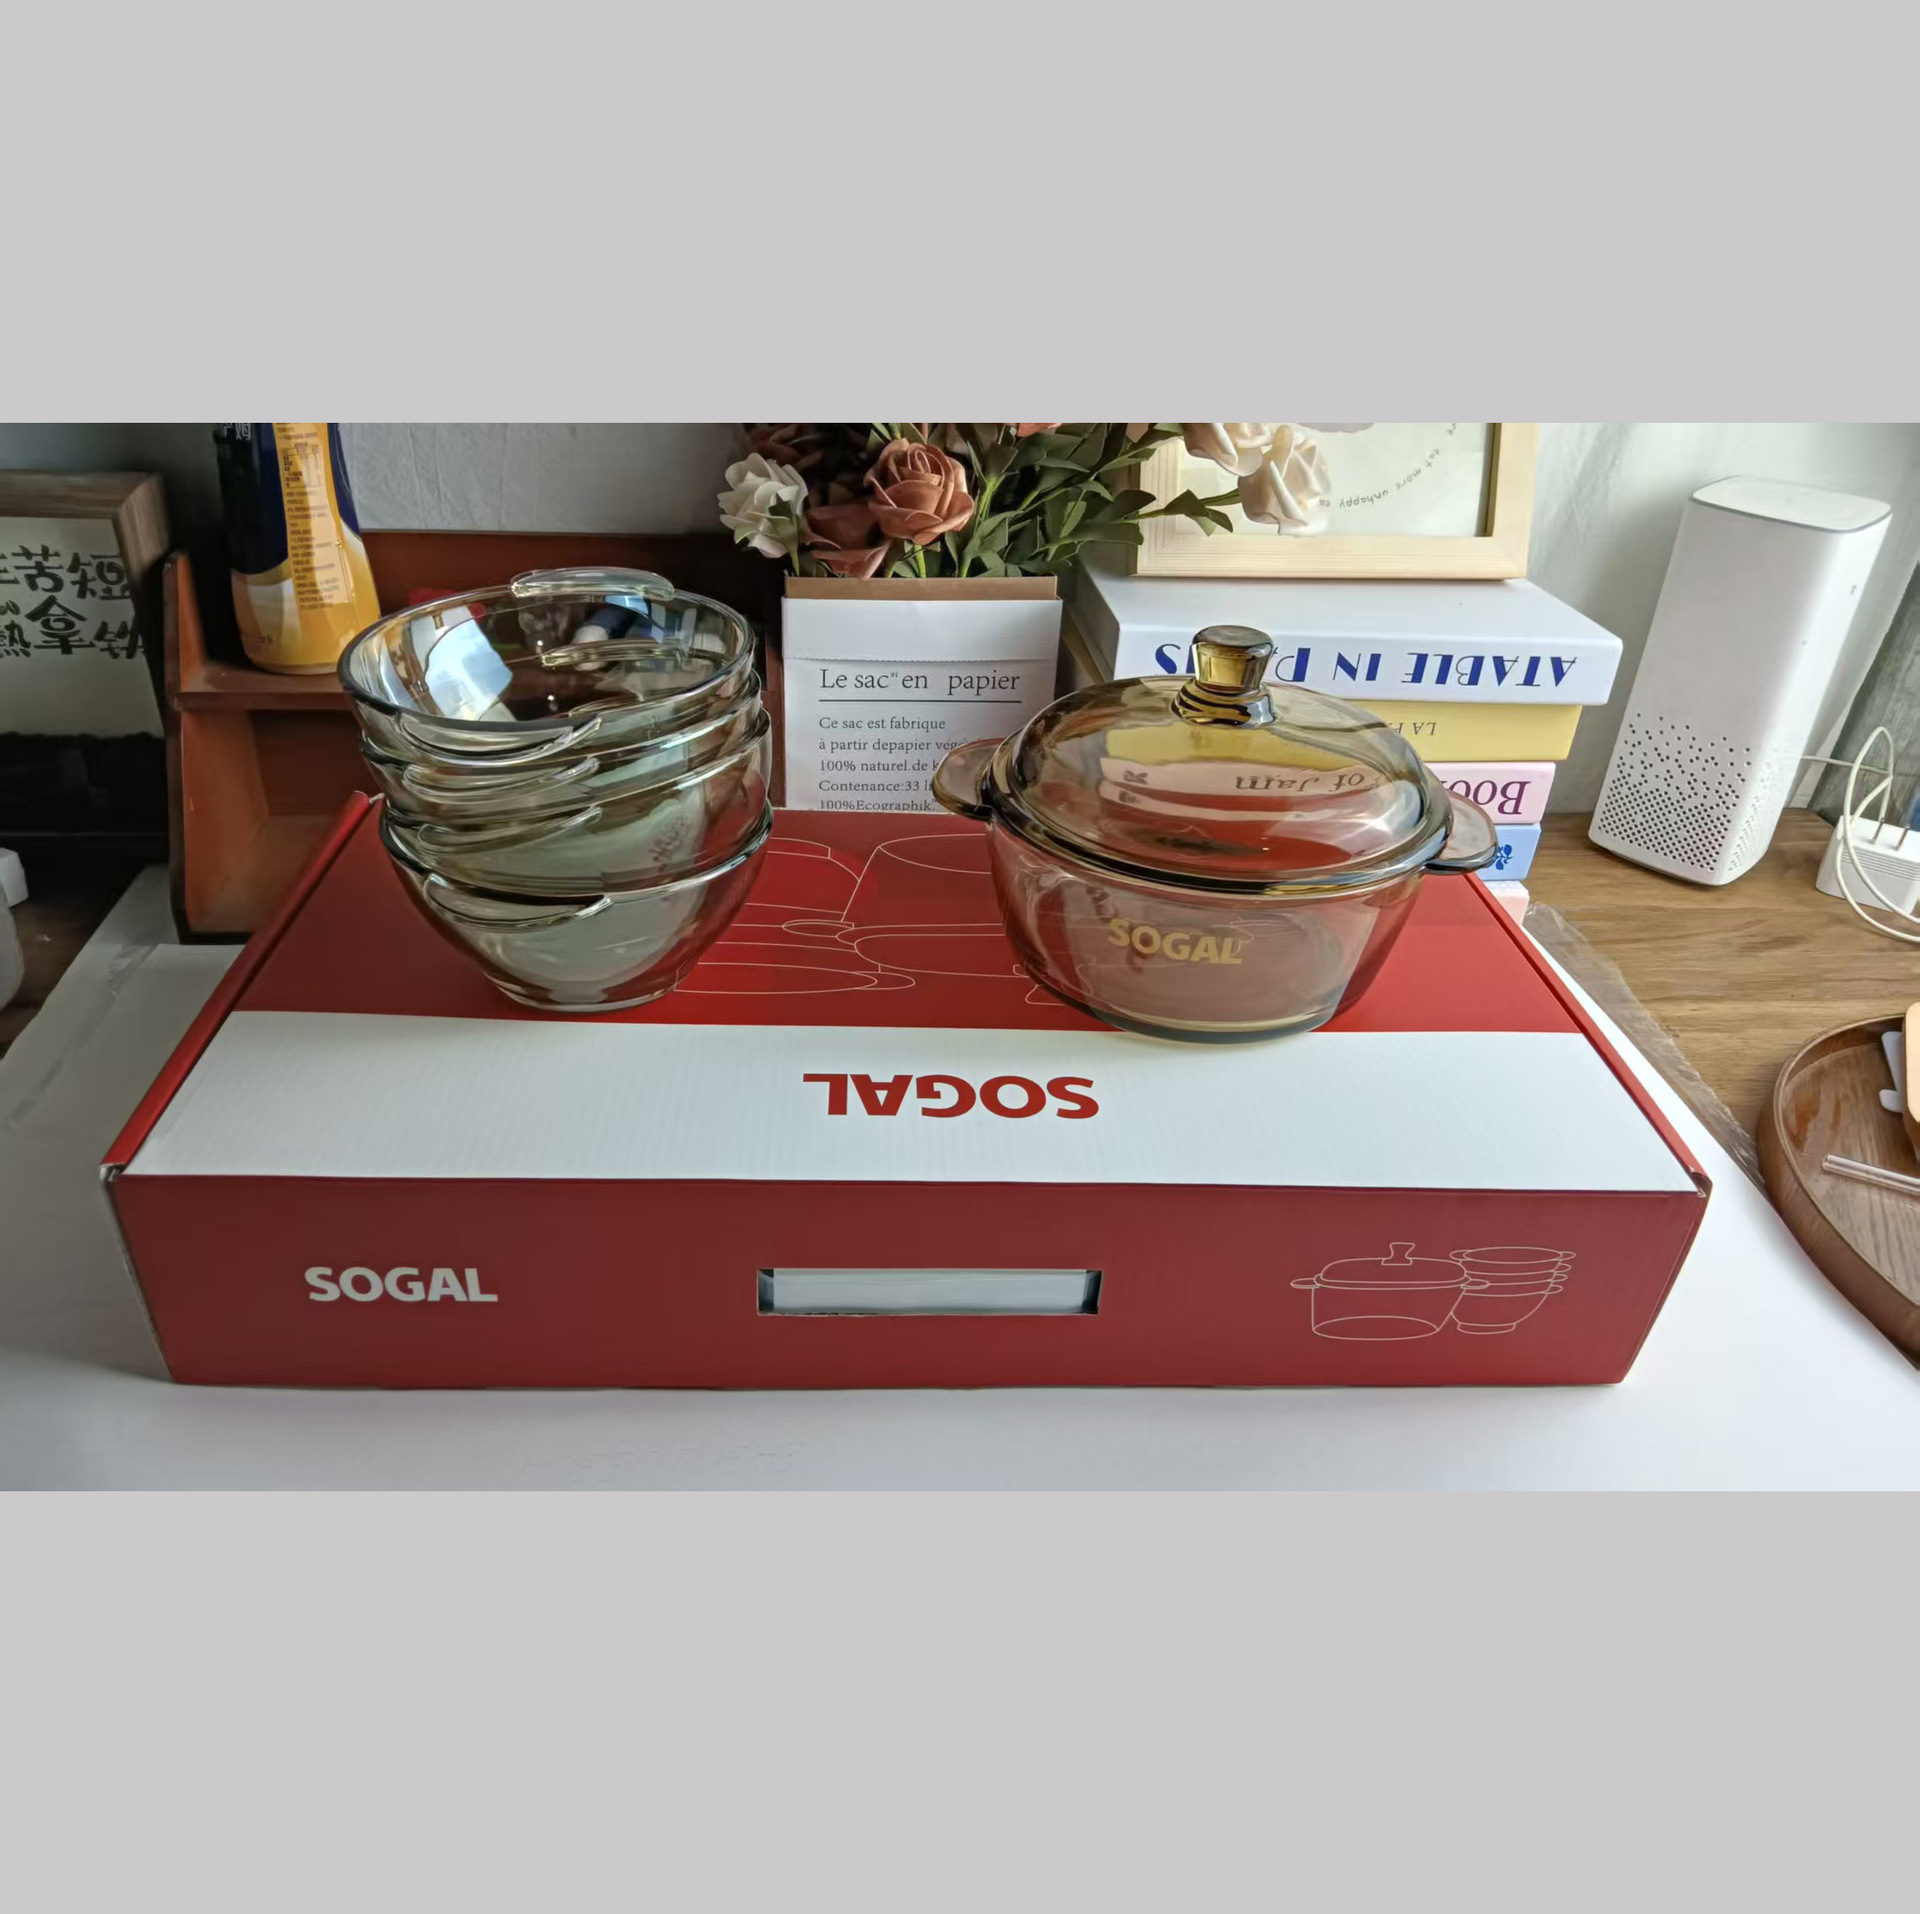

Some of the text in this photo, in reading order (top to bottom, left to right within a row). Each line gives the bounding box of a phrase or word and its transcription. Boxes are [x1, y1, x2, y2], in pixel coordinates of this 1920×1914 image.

[1339, 489, 1389, 508] unhappy
[1333, 652, 1382, 682] IN
[820, 668, 848, 689] Le
[901, 674, 928, 689] en
[947, 669, 1021, 696] papier
[819, 716, 946, 733] Ce sac est fabrique
[1412, 721, 1437, 736] LA
[830, 738, 868, 754] partir
[820, 760, 856, 772] 100%
[1107, 918, 1243, 965] SOGAL
[803, 1073, 1099, 1119] SOGAL
[304, 1266, 499, 1302] SOGAL
